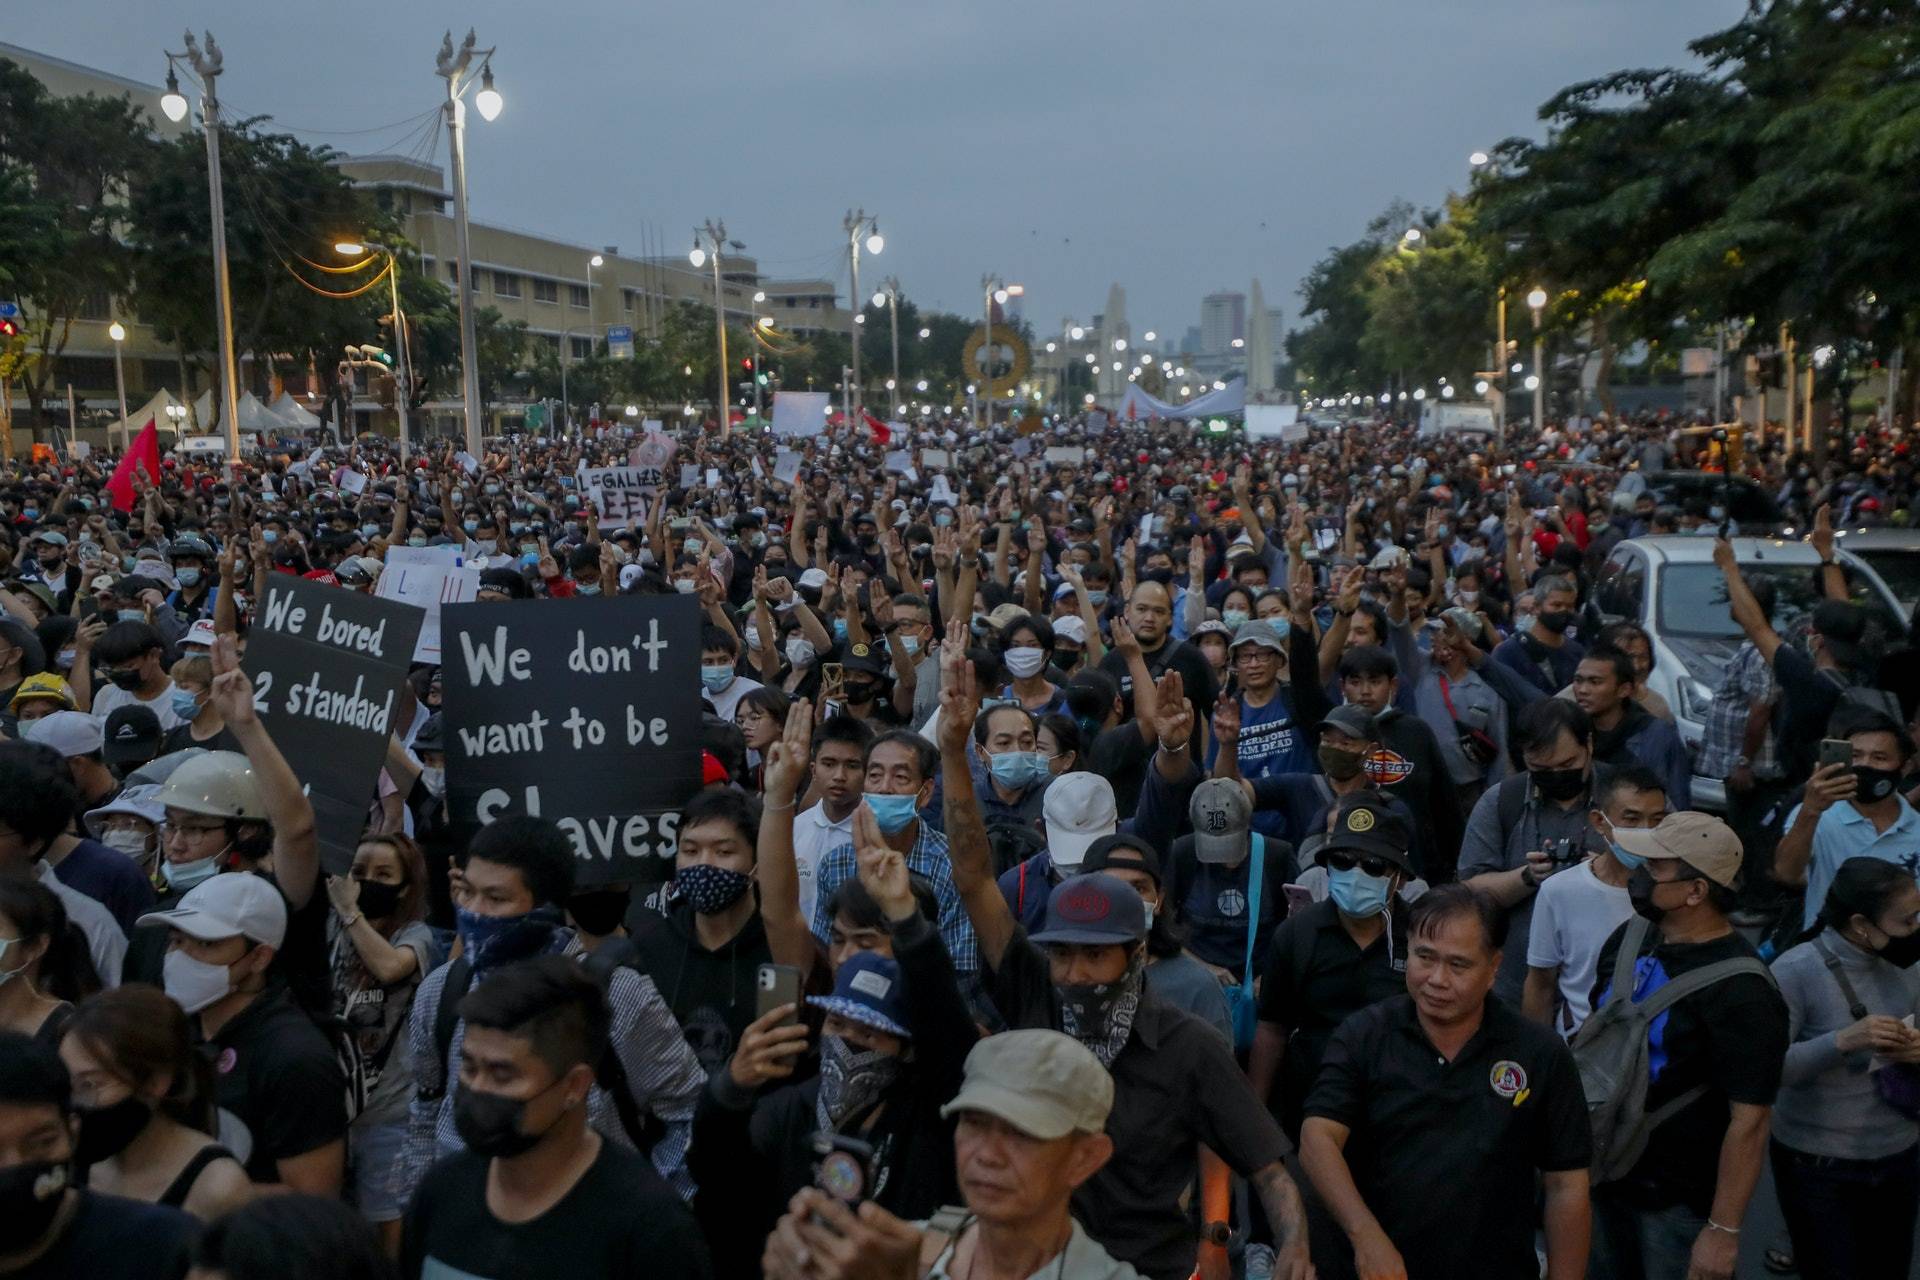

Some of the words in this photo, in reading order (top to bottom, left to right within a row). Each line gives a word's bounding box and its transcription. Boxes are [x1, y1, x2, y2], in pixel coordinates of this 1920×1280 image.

[264, 588, 306, 634] We
[317, 603, 386, 657] bored
[459, 625, 532, 686] We
[568, 618, 668, 674] don't
[253, 671, 273, 713] 2
[285, 672, 394, 735] standard
[459, 709, 549, 757] want
[562, 707, 606, 750] to
[627, 704, 669, 746] be
[1261, 738, 1293, 752] DEAD
